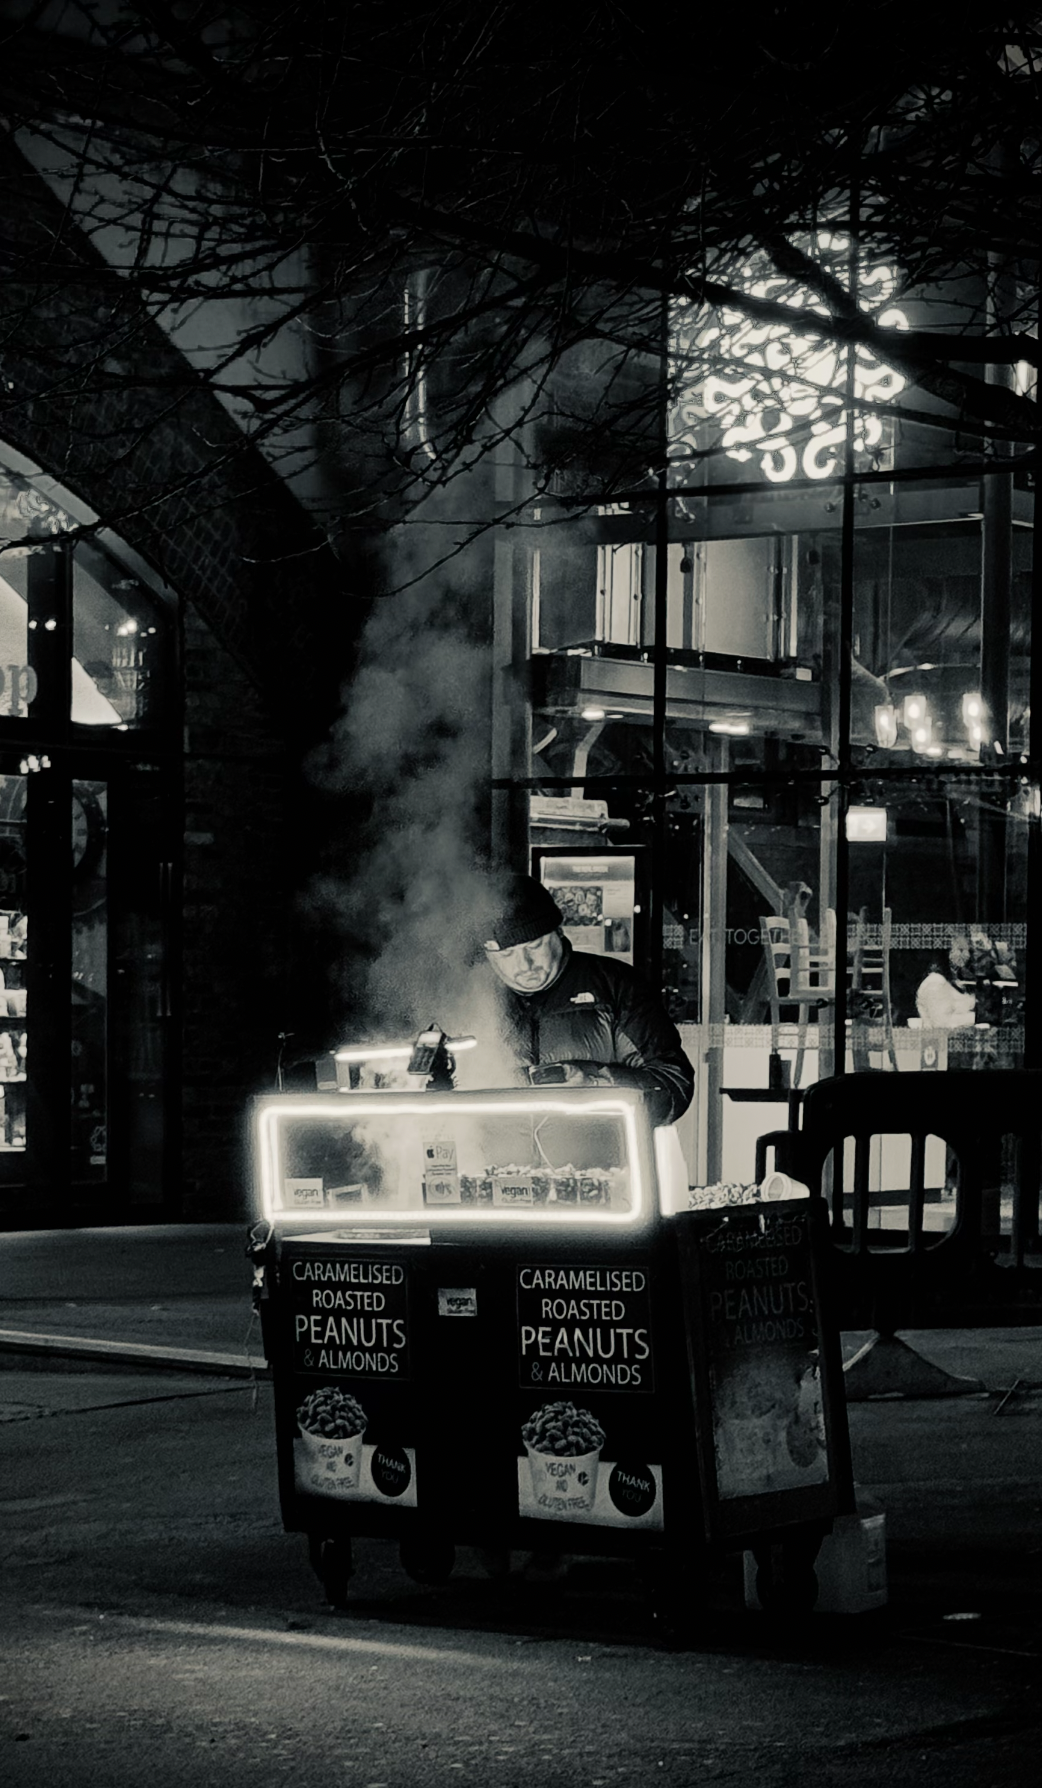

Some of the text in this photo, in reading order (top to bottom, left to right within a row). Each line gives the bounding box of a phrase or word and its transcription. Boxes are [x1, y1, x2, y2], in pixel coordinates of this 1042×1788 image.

[292, 1261, 404, 1285] CARAMELISED
[725, 1254, 789, 1281] ROASTED
[519, 1268, 646, 1292] CARAMELISED
[312, 1289, 386, 1312] ROASTED
[541, 1298, 626, 1321] ROASTED
[709, 1281, 809, 1321] PEANUTS
[294, 1314, 407, 1349] PEANUTS
[521, 1325, 650, 1360] PEANUTS
[303, 1348, 399, 1373] & ALMONDS
[531, 1361, 642, 1386] & ALMONDS
[377, 1452, 406, 1474] THANK
[545, 1461, 577, 1478] VEGAN
[617, 1470, 651, 1493] THANK
[622, 1488, 642, 1504] YOU
